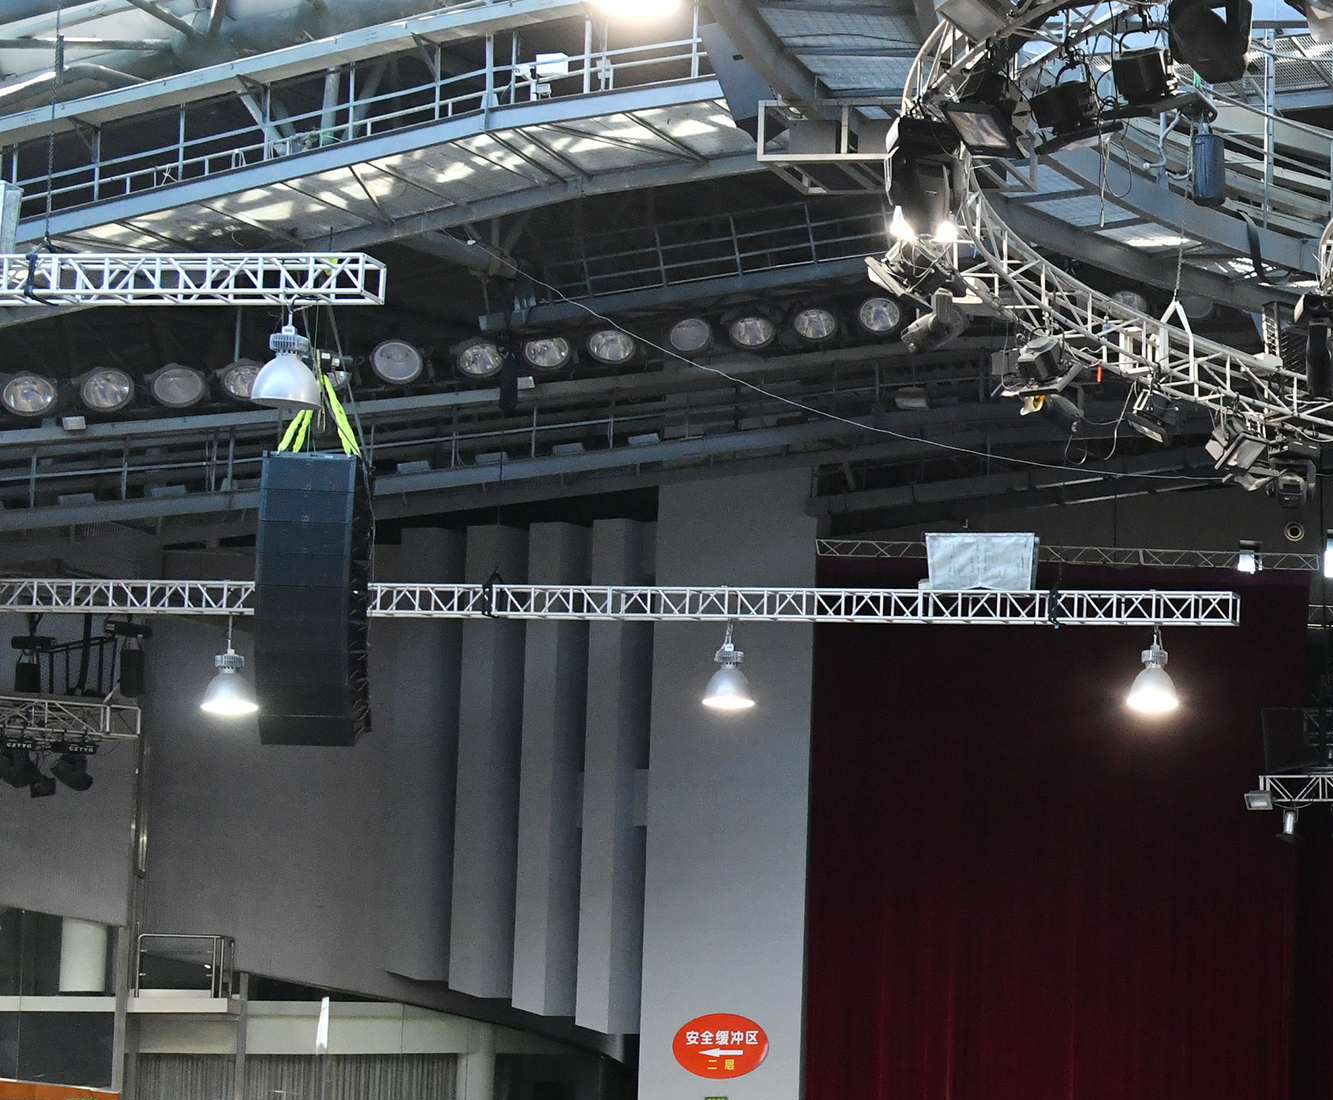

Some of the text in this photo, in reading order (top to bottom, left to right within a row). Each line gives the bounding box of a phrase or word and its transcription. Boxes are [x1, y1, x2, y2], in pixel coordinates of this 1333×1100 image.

[685, 1030, 758, 1045] 安全缓冲区
